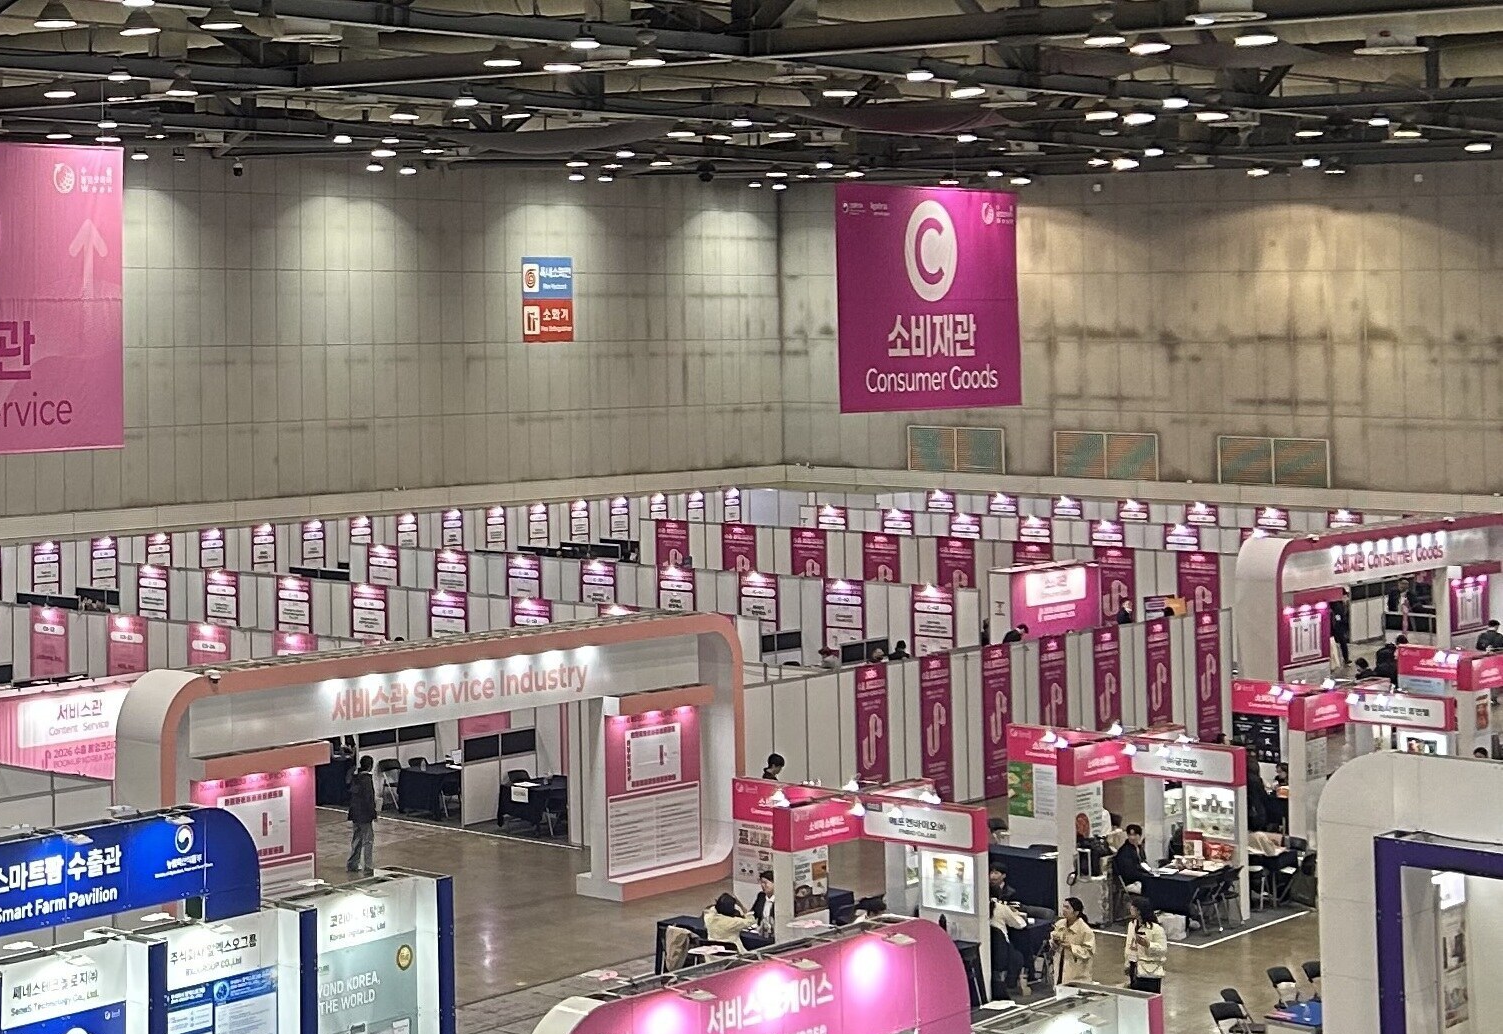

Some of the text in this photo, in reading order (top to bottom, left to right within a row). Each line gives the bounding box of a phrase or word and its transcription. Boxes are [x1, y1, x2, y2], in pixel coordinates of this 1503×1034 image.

[915, 217, 946, 285] C
[887, 314, 977, 358] 소비재관
[865, 364, 998, 394] Consumer Goods
[332, 663, 589, 721] 서비스관 Service Industry
[57, 699, 102, 720] 서비스관
[67, 845, 123, 881] 수출관
[34, 896, 67, 917] Farm
[68, 886, 119, 911] Pavilion
[346, 970, 381, 992] KOREA,
[319, 988, 376, 1015] THE WORLD
